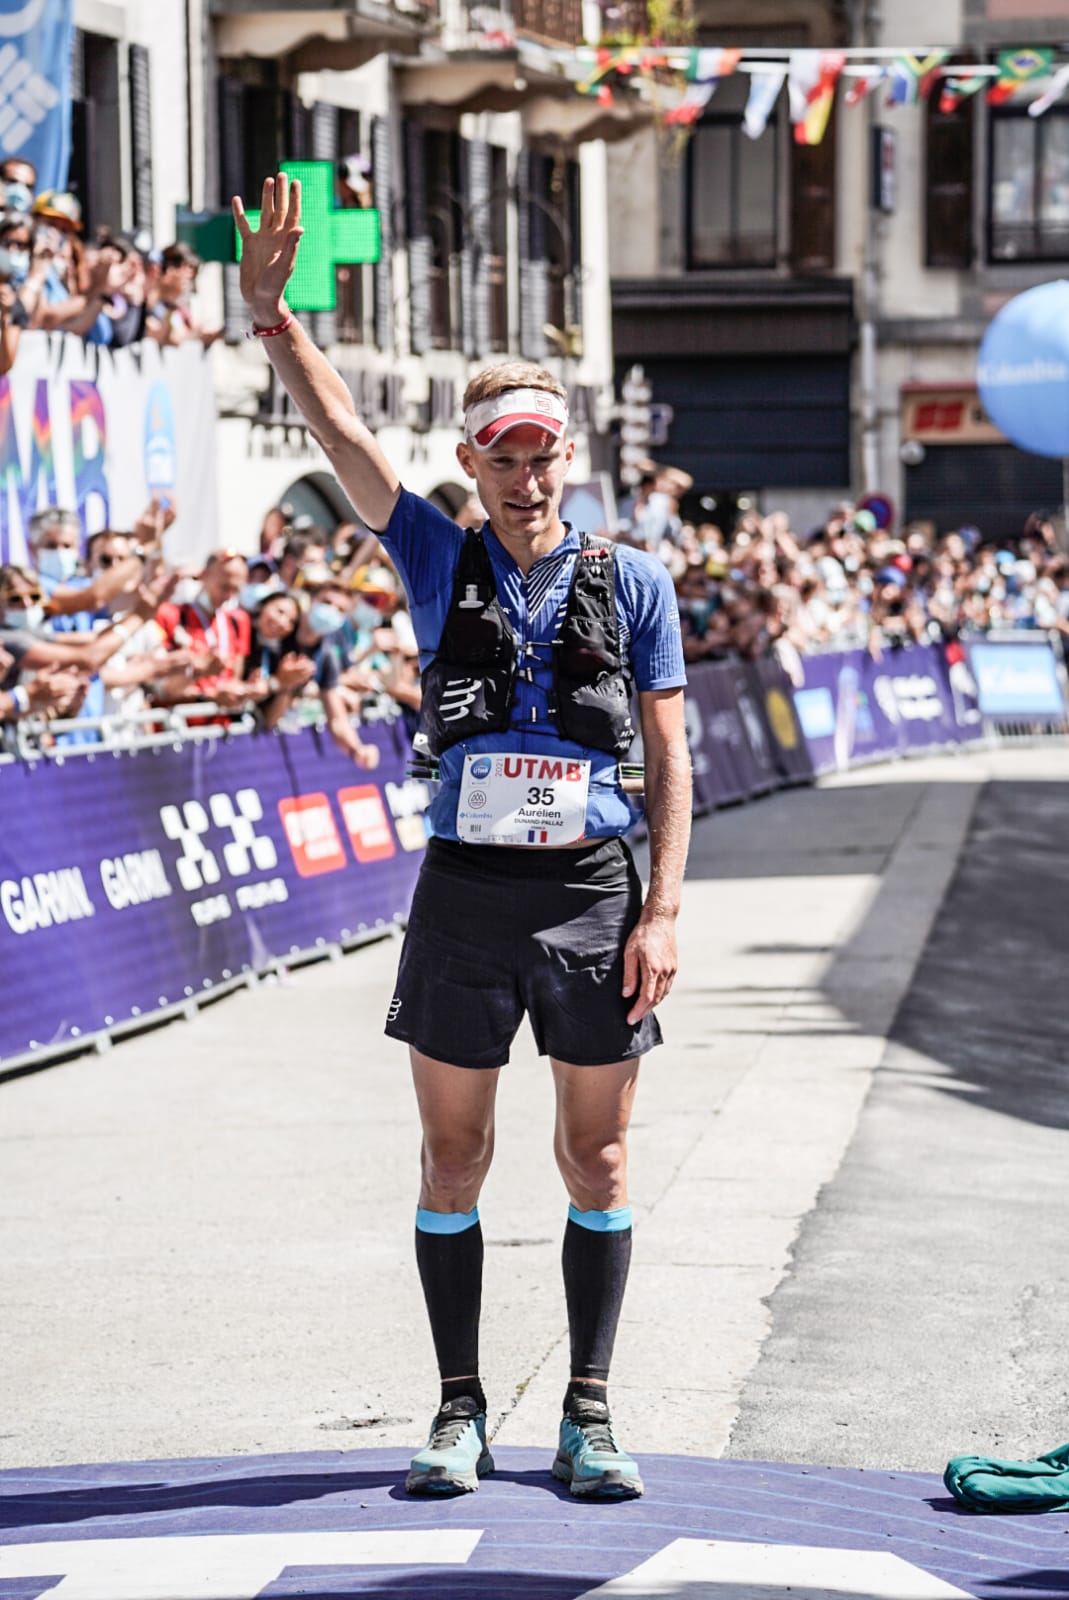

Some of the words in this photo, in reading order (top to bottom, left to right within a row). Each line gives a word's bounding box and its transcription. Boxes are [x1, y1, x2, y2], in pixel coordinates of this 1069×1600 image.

[504, 757, 582, 782] UTMB
[527, 787, 555, 806] 35
[518, 807, 561, 818] Aurélien
[0, 866, 95, 934] GARMIN
